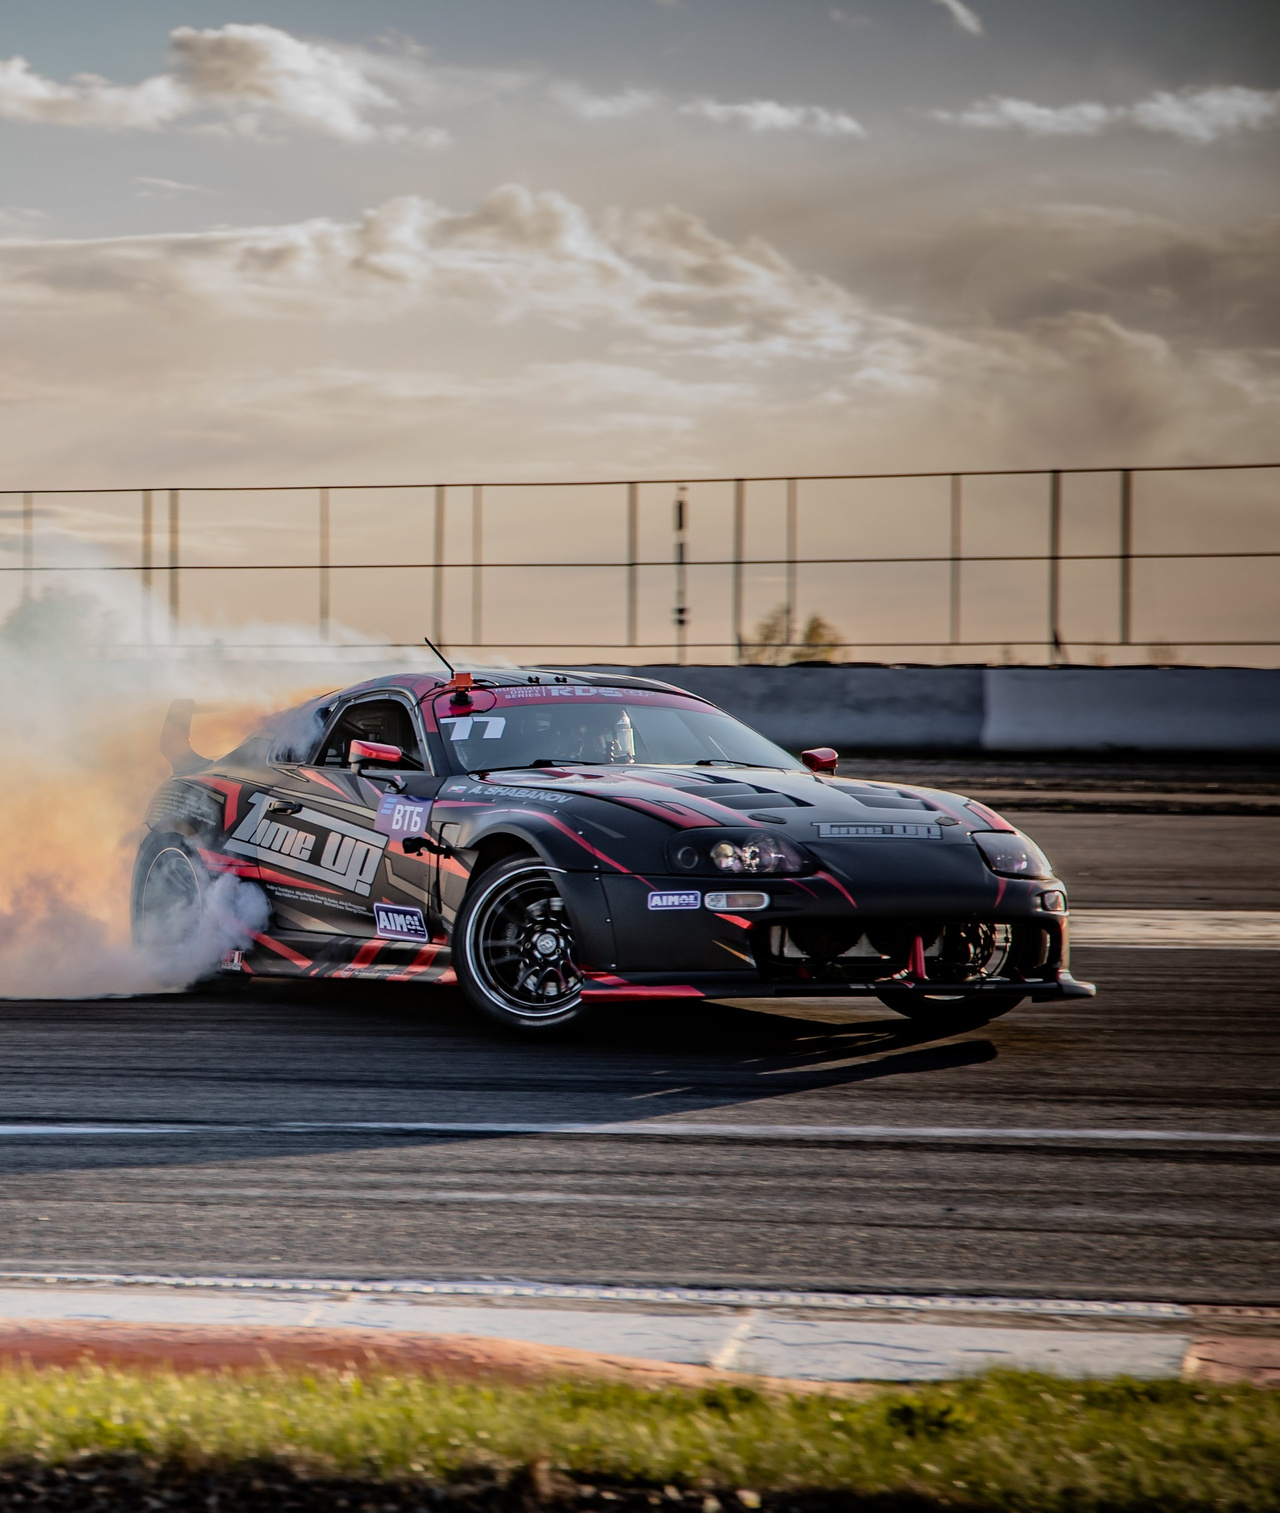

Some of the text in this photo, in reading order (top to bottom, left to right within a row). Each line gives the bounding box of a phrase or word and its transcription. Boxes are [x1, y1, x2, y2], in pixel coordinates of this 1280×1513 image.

[547, 685, 624, 698] RDS
[439, 716, 507, 741] 77
[467, 785, 574, 804] A. SHABANOV
[651, 893, 700, 907] AIMOL
[379, 910, 426, 936] AIMOL
